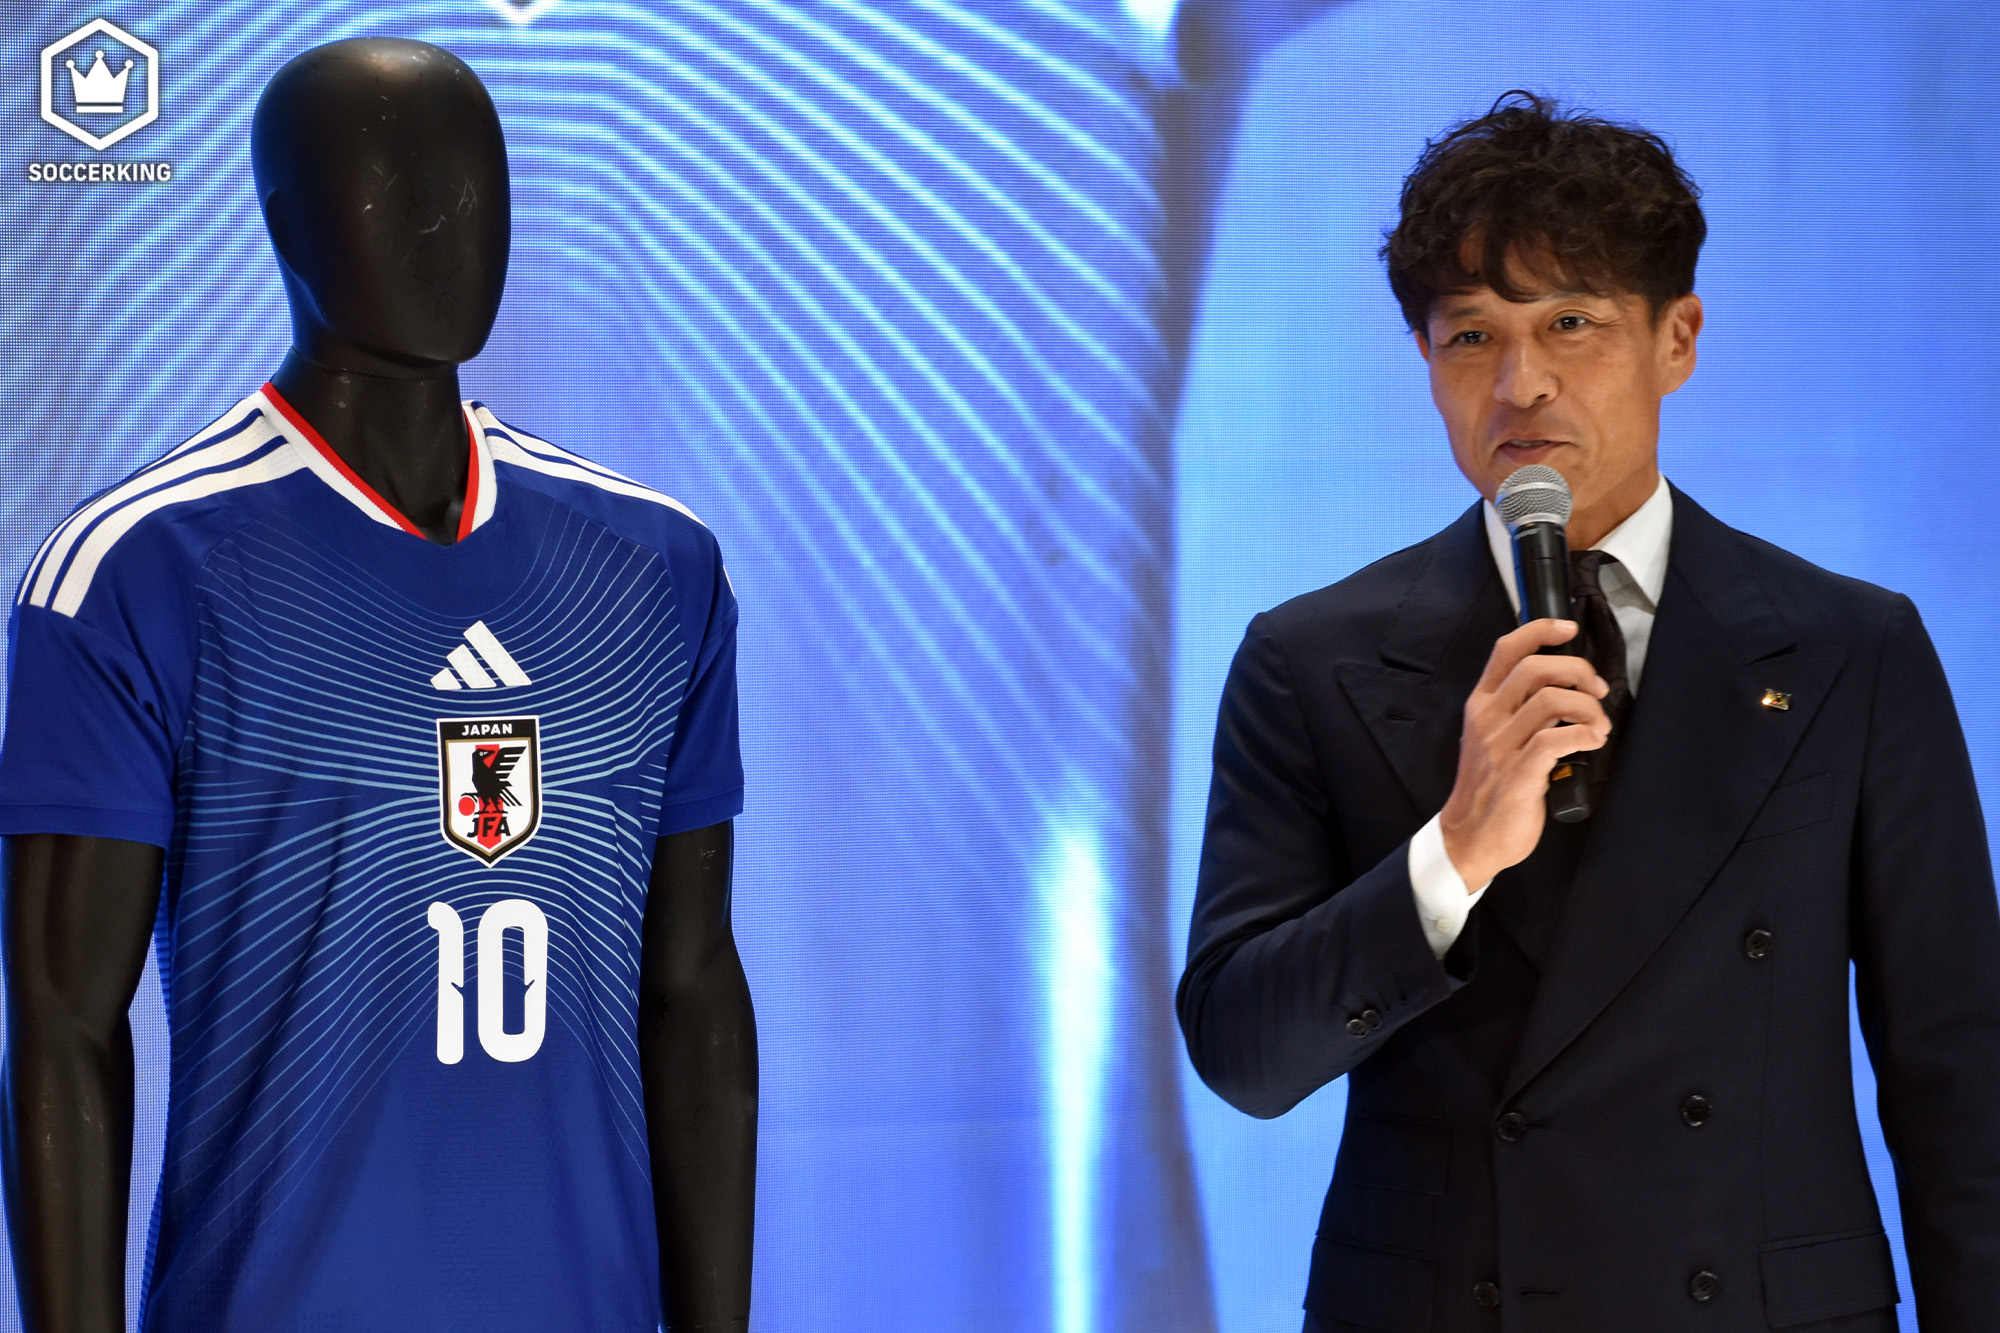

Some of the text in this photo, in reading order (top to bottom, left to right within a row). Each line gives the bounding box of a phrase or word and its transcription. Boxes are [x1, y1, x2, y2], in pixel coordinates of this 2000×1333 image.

[461, 723, 513, 736] JAPAN
[466, 817, 511, 838] JFA
[427, 899, 548, 1065] 10
